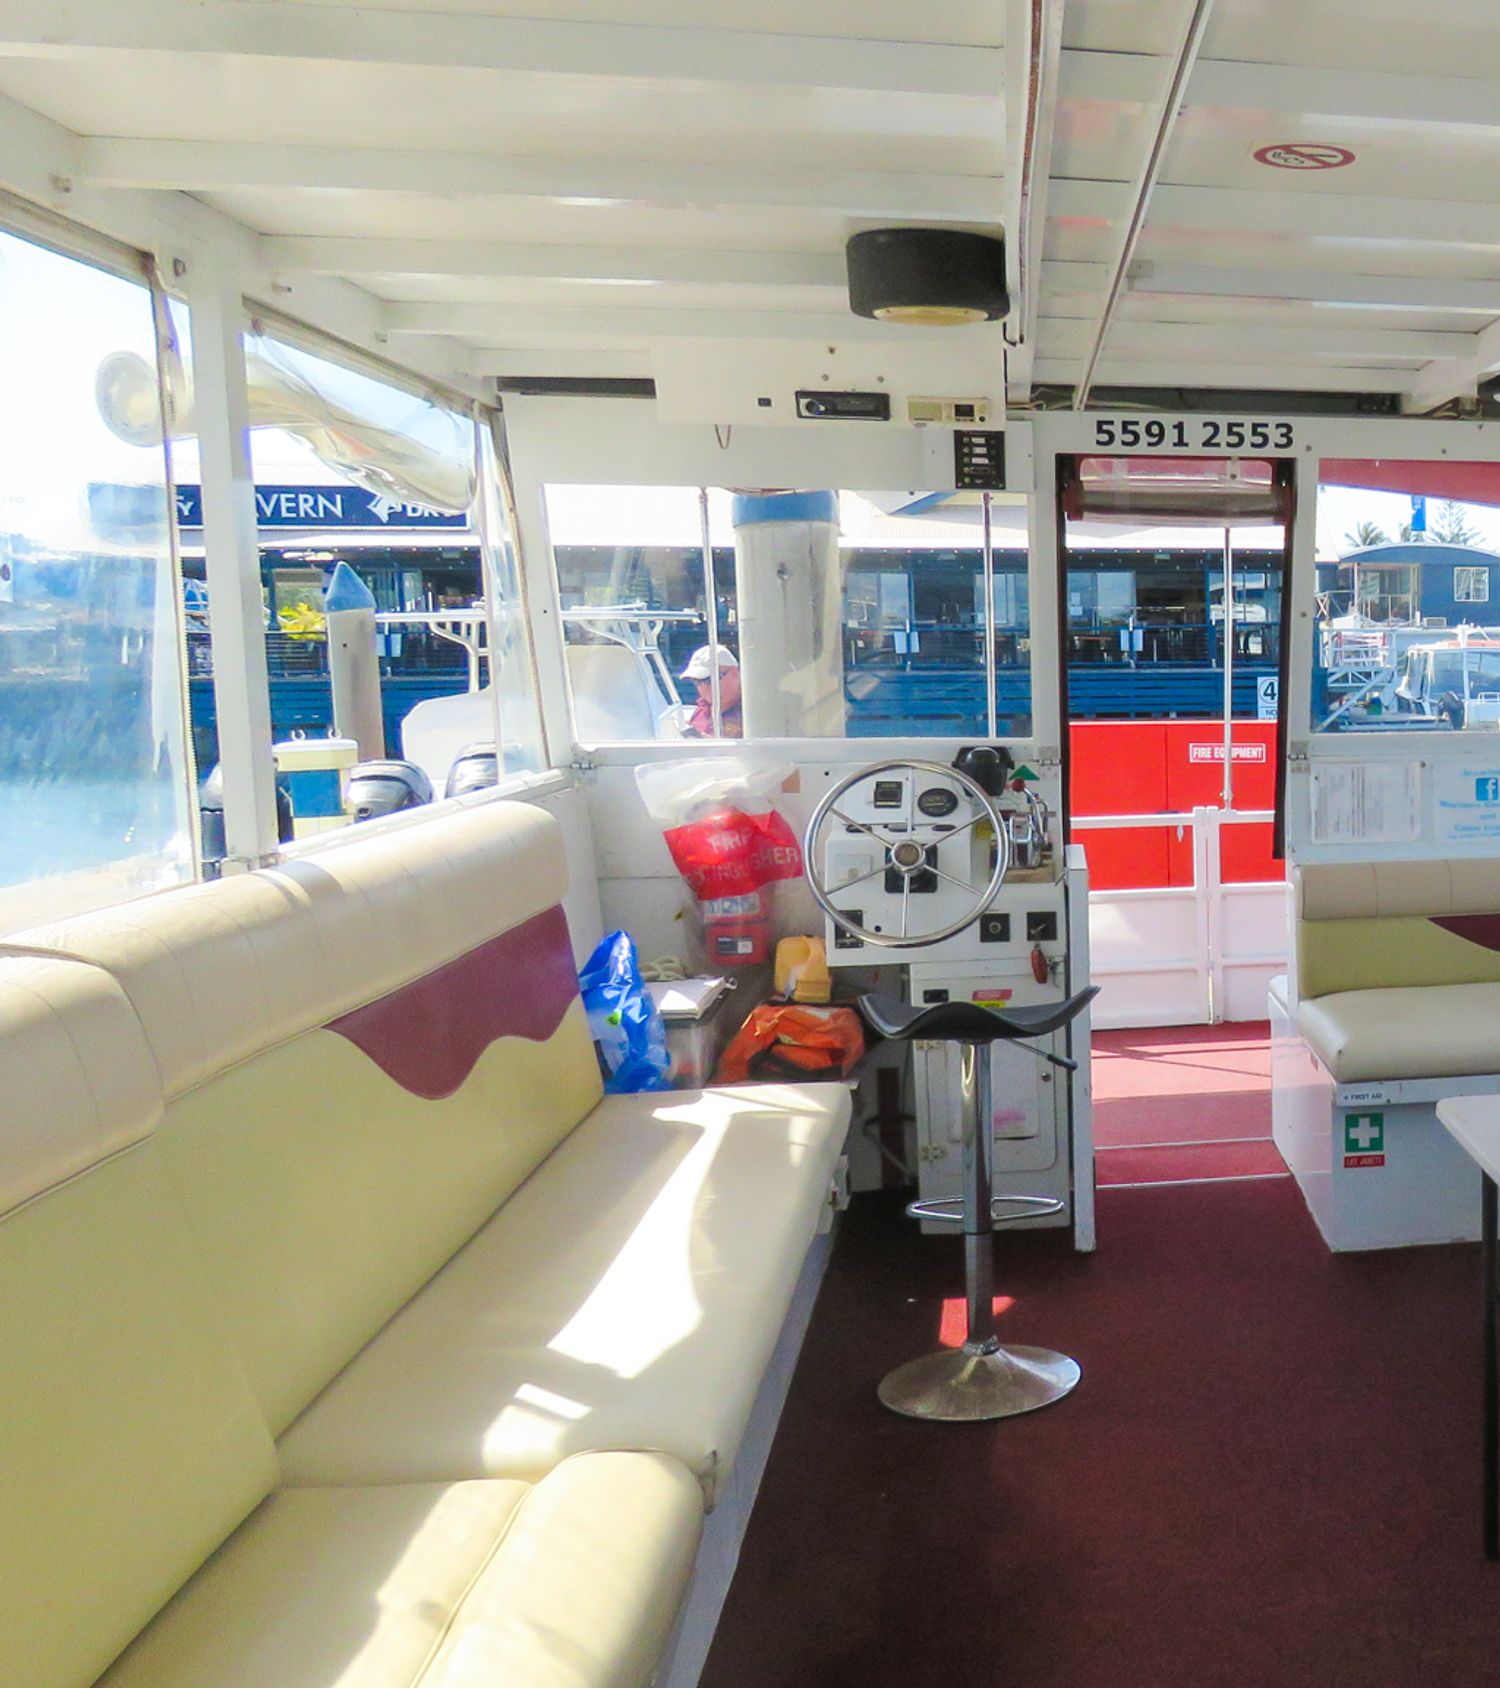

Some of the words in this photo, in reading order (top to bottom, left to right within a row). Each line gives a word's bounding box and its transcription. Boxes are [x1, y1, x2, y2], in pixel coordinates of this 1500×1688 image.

[1095, 420, 1189, 447] 5591
[1201, 422, 1294, 449] 2553
[256, 493, 343, 518] VERN
[1263, 681, 1277, 701] 4
[1193, 746, 1212, 759] FIRE
[1214, 746, 1263, 759] EQIPMENT
